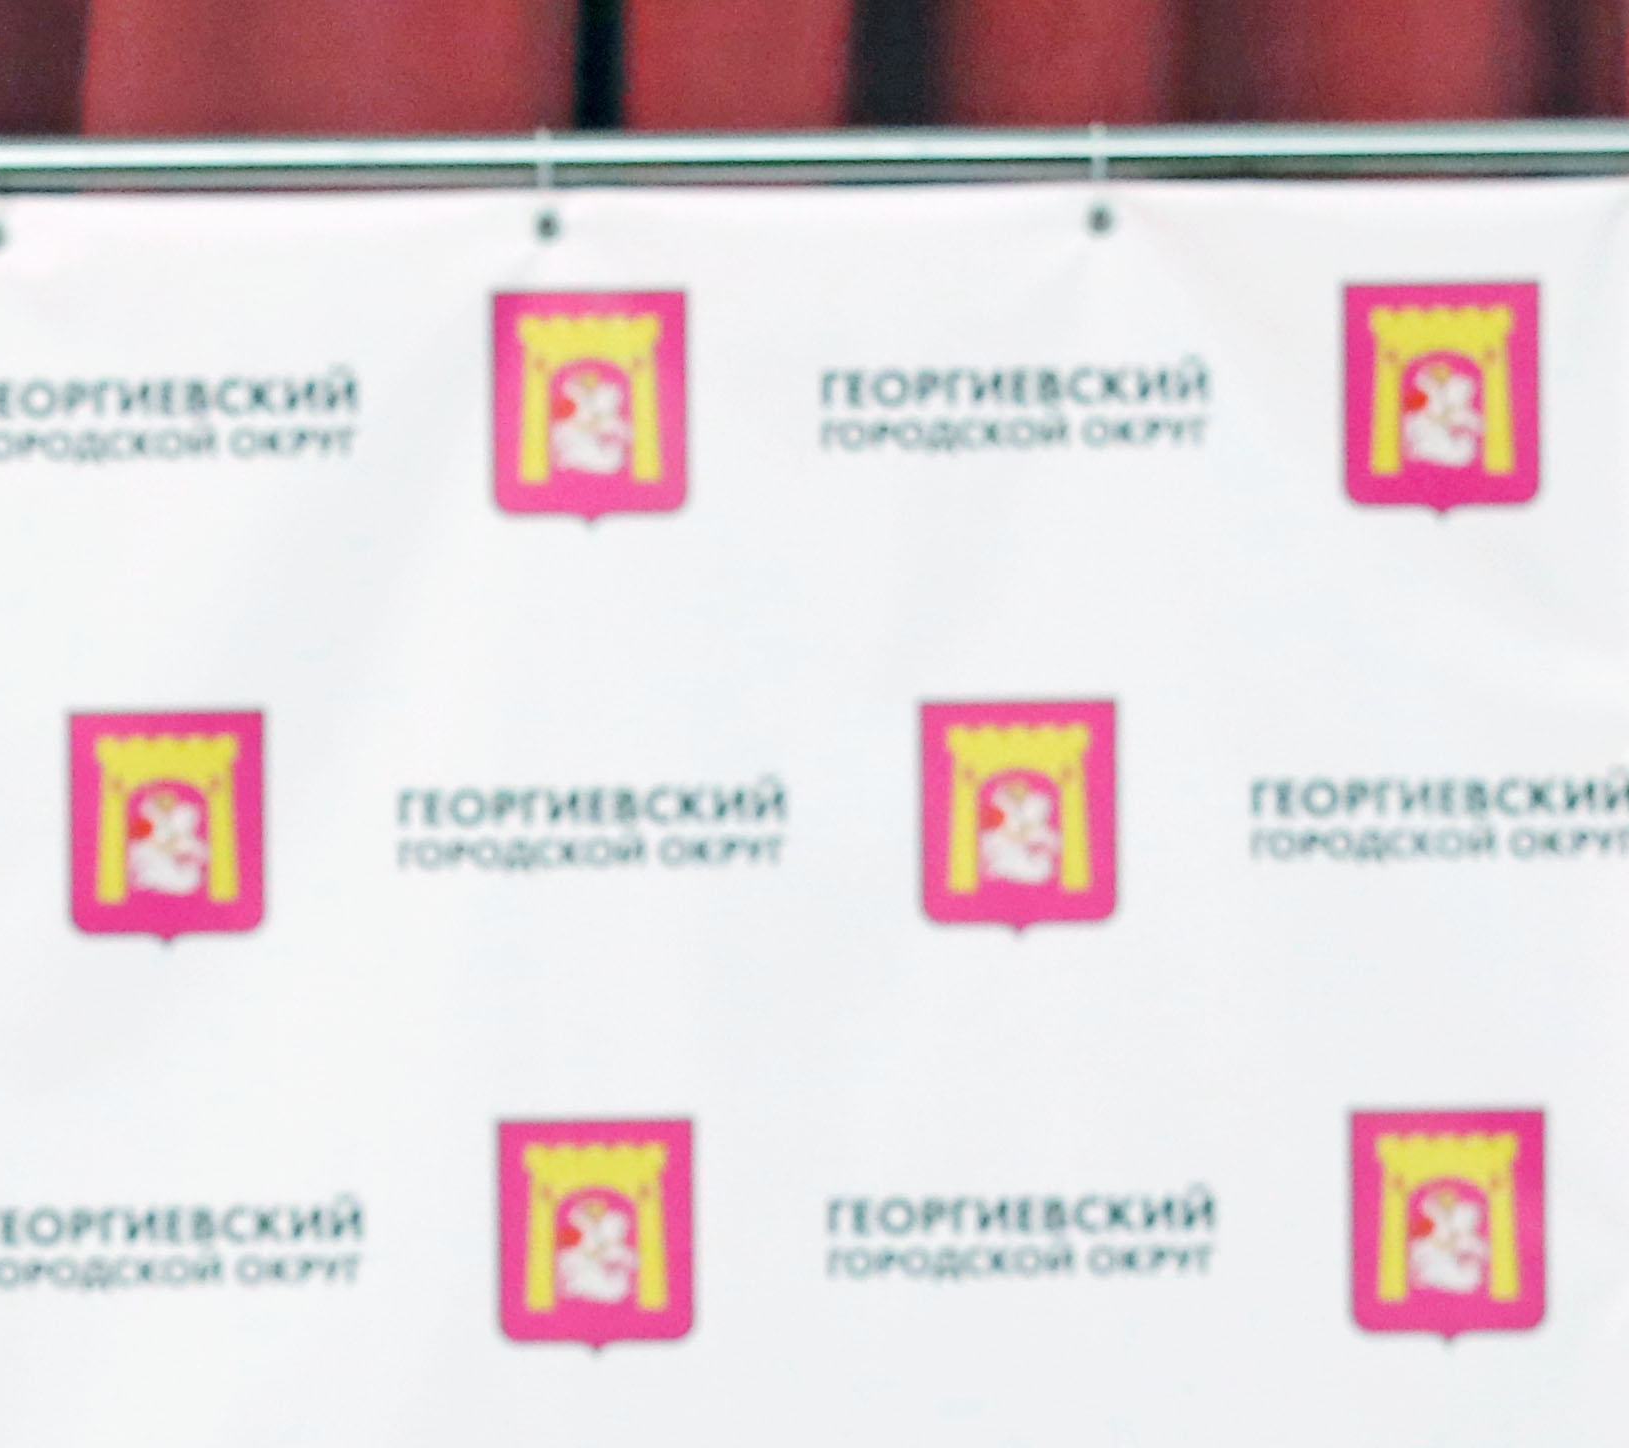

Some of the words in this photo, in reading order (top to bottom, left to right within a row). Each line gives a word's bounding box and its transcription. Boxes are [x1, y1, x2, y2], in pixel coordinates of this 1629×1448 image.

[821, 357, 1209, 408] ГЕОРГИЕВСКИЙ
[230, 427, 354, 456] ОКРУГ
[821, 416, 1069, 452] ГОРОДСКОЙ
[1082, 417, 1205, 446] ОКРУГ
[398, 776, 787, 827] ГЕОРГИЕВСКИЙ
[398, 835, 647, 871] ГОРОДСКОЙ
[658, 837, 781, 866] ОКРУГ
[1251, 827, 1497, 862] ГОРОДСКОЙ
[827, 1184, 1216, 1235] ГЕОРГИЕВСКИЙ
[236, 1254, 359, 1284] ОКРУГ
[828, 1244, 1075, 1280] ГОРОДСКОЙ
[1088, 1245, 1211, 1275] ОКРУГ
